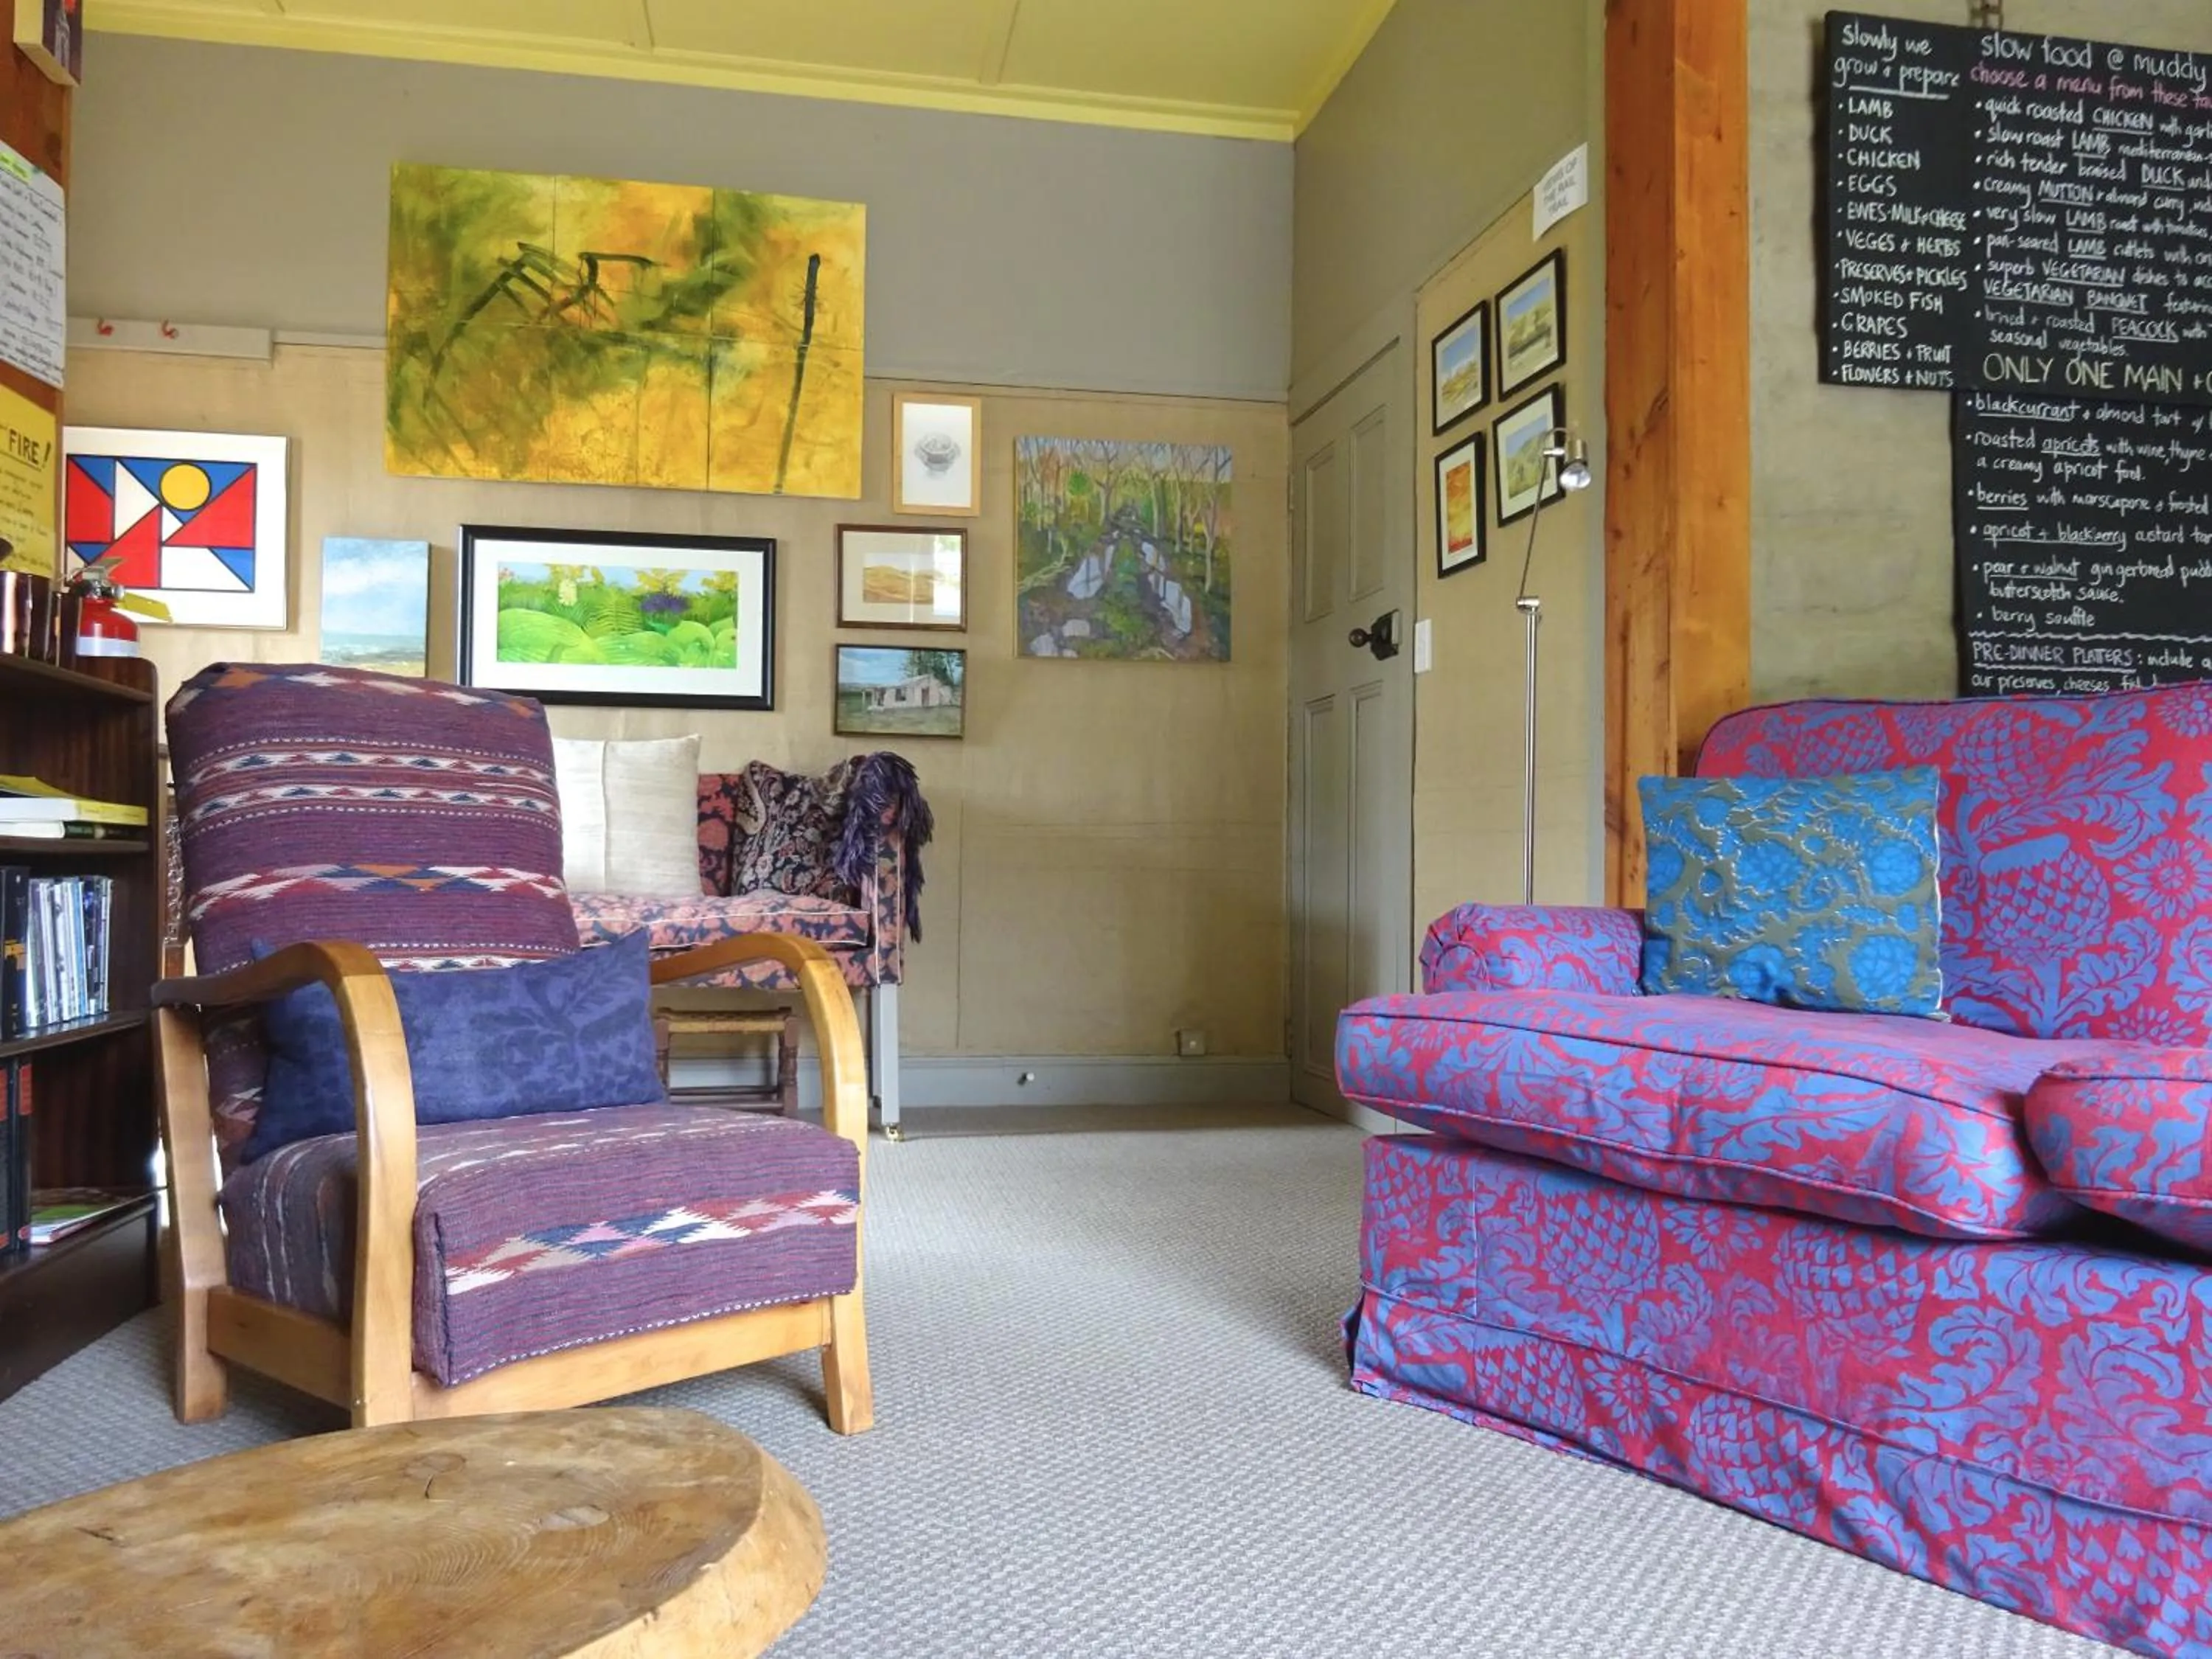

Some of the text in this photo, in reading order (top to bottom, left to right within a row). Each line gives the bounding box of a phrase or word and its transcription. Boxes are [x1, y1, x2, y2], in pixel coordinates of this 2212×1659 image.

[1905, 39, 1933, 55] we
[1832, 57, 1878, 88] grow
[1899, 65, 1960, 94] prepare
[2041, 36, 2091, 69] food
[2134, 52, 2206, 94] muddy
[1971, 61, 2028, 88] choose
[2034, 74, 2047, 91] a
[2056, 77, 2101, 94] menu
[2109, 75, 2143, 102] from
[2151, 80, 2188, 107] these
[1848, 97, 1893, 118] LAMB
[1985, 96, 2022, 123] quick
[2026, 99, 2083, 124] roasted
[2093, 107, 2153, 131] CHICKEN
[1848, 123, 1893, 145] DUCK
[1847, 149, 1920, 170] CHICKEN
[1986, 150, 2015, 169] rich
[2020, 152, 2068, 174] tender
[2141, 163, 2185, 185] DUCK
[1848, 174, 1897, 197] EGGS
[2038, 179, 2093, 201] MUTTON
[1986, 207, 2018, 232] very
[2023, 202, 2056, 224] slow
[2066, 209, 2107, 231] LAMB
[1846, 229, 1895, 251] VEGES
[1917, 236, 1961, 257] HERBS
[2068, 237, 2107, 255] LAMB
[1916, 266, 1967, 291] PICKLES
[1987, 257, 2034, 282] superb
[2042, 259, 2125, 285] VEGETARIAN
[1840, 285, 1904, 308] SMOKED
[1983, 279, 2073, 305] VEGETARIAN
[1841, 312, 1907, 338] GRAPES
[2046, 308, 2095, 333] roasted
[2112, 316, 2178, 340] PEACOCK
[1843, 340, 1901, 360] BERRIES
[1916, 344, 1952, 363] FRUIT
[1989, 330, 2047, 349] seasonal
[1842, 364, 1899, 383] FLOWERS
[1916, 370, 1953, 387] NUTS
[1983, 352, 2055, 383] ONLY
[2065, 358, 2115, 389] ONE
[2124, 364, 2183, 394] MAIN
[1975, 392, 2081, 420] blackcurrant
[2096, 402, 2145, 424] almond
[2152, 406, 2182, 427] tart
[1974, 427, 2036, 448] roasted
[1977, 456, 1988, 468] a
[1993, 457, 2042, 483] creamy
[2053, 458, 2108, 483] apricot
[1976, 481, 2028, 507] berries
[1983, 520, 2035, 549] apricot
[2057, 521, 2126, 552] blackberry
[1983, 561, 2014, 584] pear
[2033, 554, 2081, 577] walnut
[1990, 580, 2071, 601] butterscotch
[1992, 605, 2036, 632] berry
[1972, 674, 1994, 688] our
